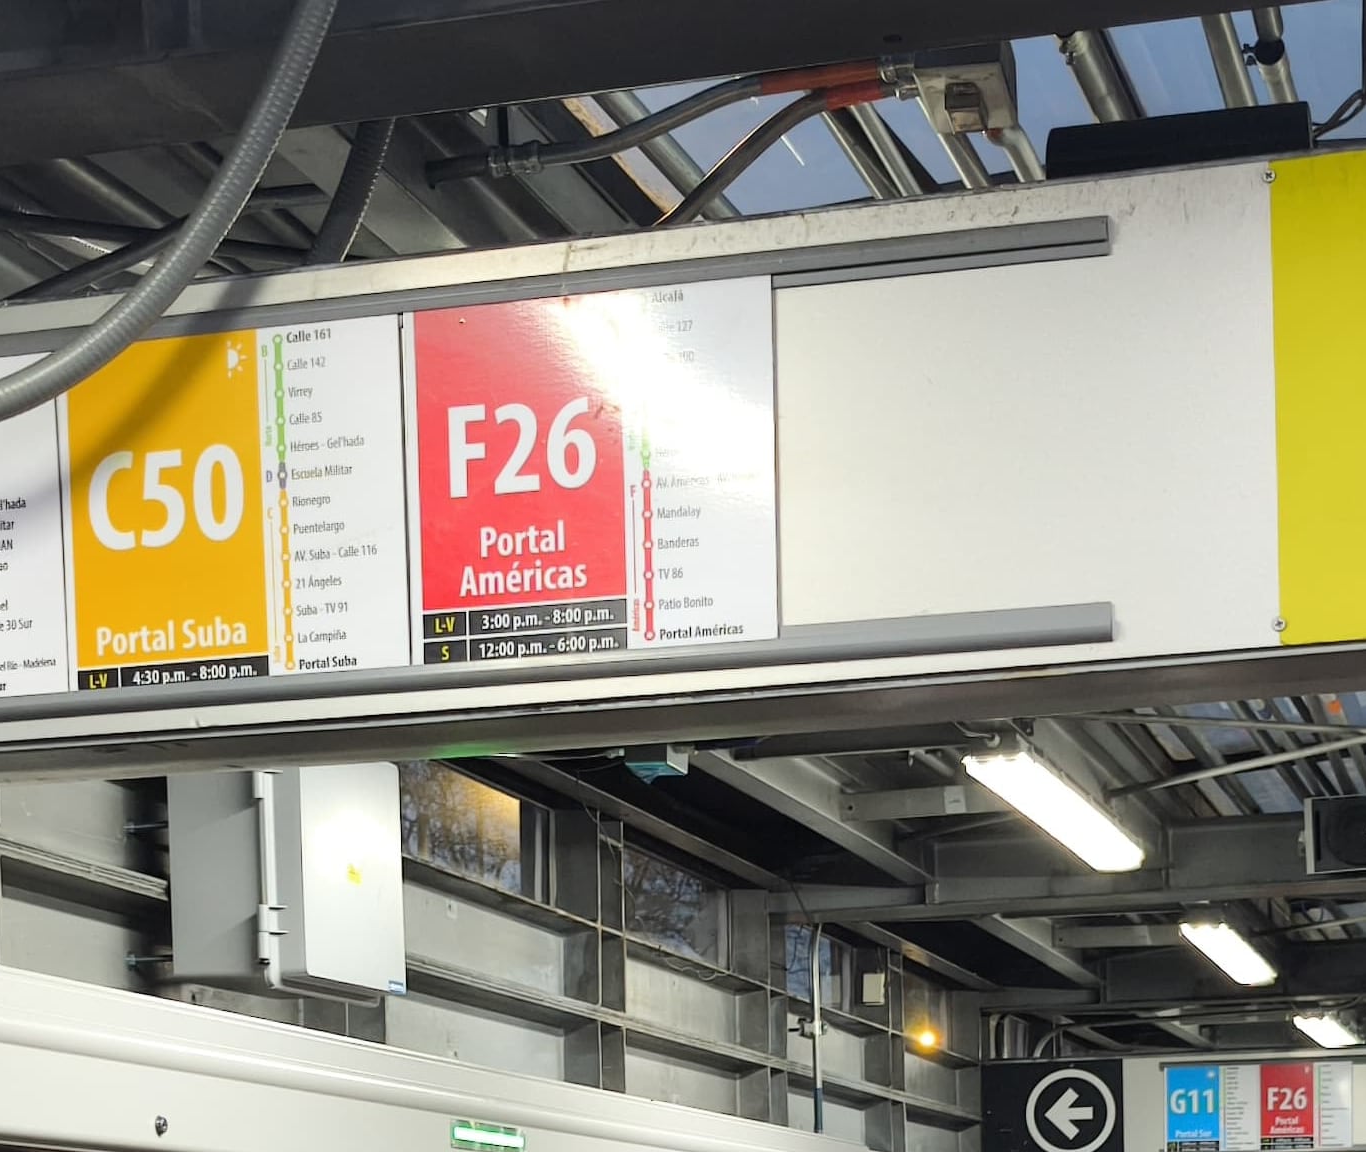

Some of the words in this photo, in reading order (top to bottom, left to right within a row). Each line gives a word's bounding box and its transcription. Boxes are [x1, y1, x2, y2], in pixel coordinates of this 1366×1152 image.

[286, 330, 312, 344] Calle
[314, 328, 332, 341] 161
[287, 358, 308, 371] Calle
[311, 356, 326, 369] 142
[288, 386, 313, 399] Virrey
[289, 412, 310, 426] Calle
[447, 396, 597, 500] F26
[291, 467, 323, 481] Escuela
[325, 464, 353, 477] Militar
[88, 444, 245, 552] C50
[292, 495, 331, 509] Rionegro
[657, 506, 702, 520] Mandalay
[293, 521, 345, 536] Puentelargo
[480, 519, 566, 558] Portal
[657, 536, 700, 550] Banderas
[309, 548, 332, 561] Suba
[338, 545, 360, 559] Calle
[362, 543, 378, 557] 116
[459, 559, 588, 599] Américas
[658, 568, 671, 580] TV
[672, 567, 684, 579] 86
[296, 578, 306, 590] 21
[296, 603, 318, 617] Suba
[324, 602, 337, 615] TV
[338, 601, 349, 614] 91
[659, 598, 682, 611] Patio
[684, 596, 714, 609] Bonito
[6, 619, 17, 631] 30
[19, 619, 33, 630] Sur
[435, 616, 456, 634] L-V
[481, 613, 511, 630] 3:00
[513, 613, 544, 630] p.m.
[552, 607, 582, 624] 8:00
[584, 608, 615, 626] p.m.
[97, 619, 176, 657] Portal
[182, 616, 248, 650] Suba
[298, 632, 308, 644] La
[660, 626, 693, 641] Portal
[695, 623, 745, 638] Américas
[441, 645, 450, 661] S
[479, 641, 515, 659] 12:00
[517, 641, 548, 659] p.m.
[557, 635, 586, 653] 6:00
[588, 635, 620, 654] p.m.
[299, 656, 331, 671] Portal
[332, 654, 358, 668] Suba
[89, 673, 108, 690] L-V
[132, 669, 161, 686] 4:30
[162, 668, 190, 685] p.m.
[199, 664, 226, 680] 8:00
[229, 663, 257, 679] p.m.
[1170, 1088, 1215, 1115] G11
[1267, 1086, 1308, 1112] F26
